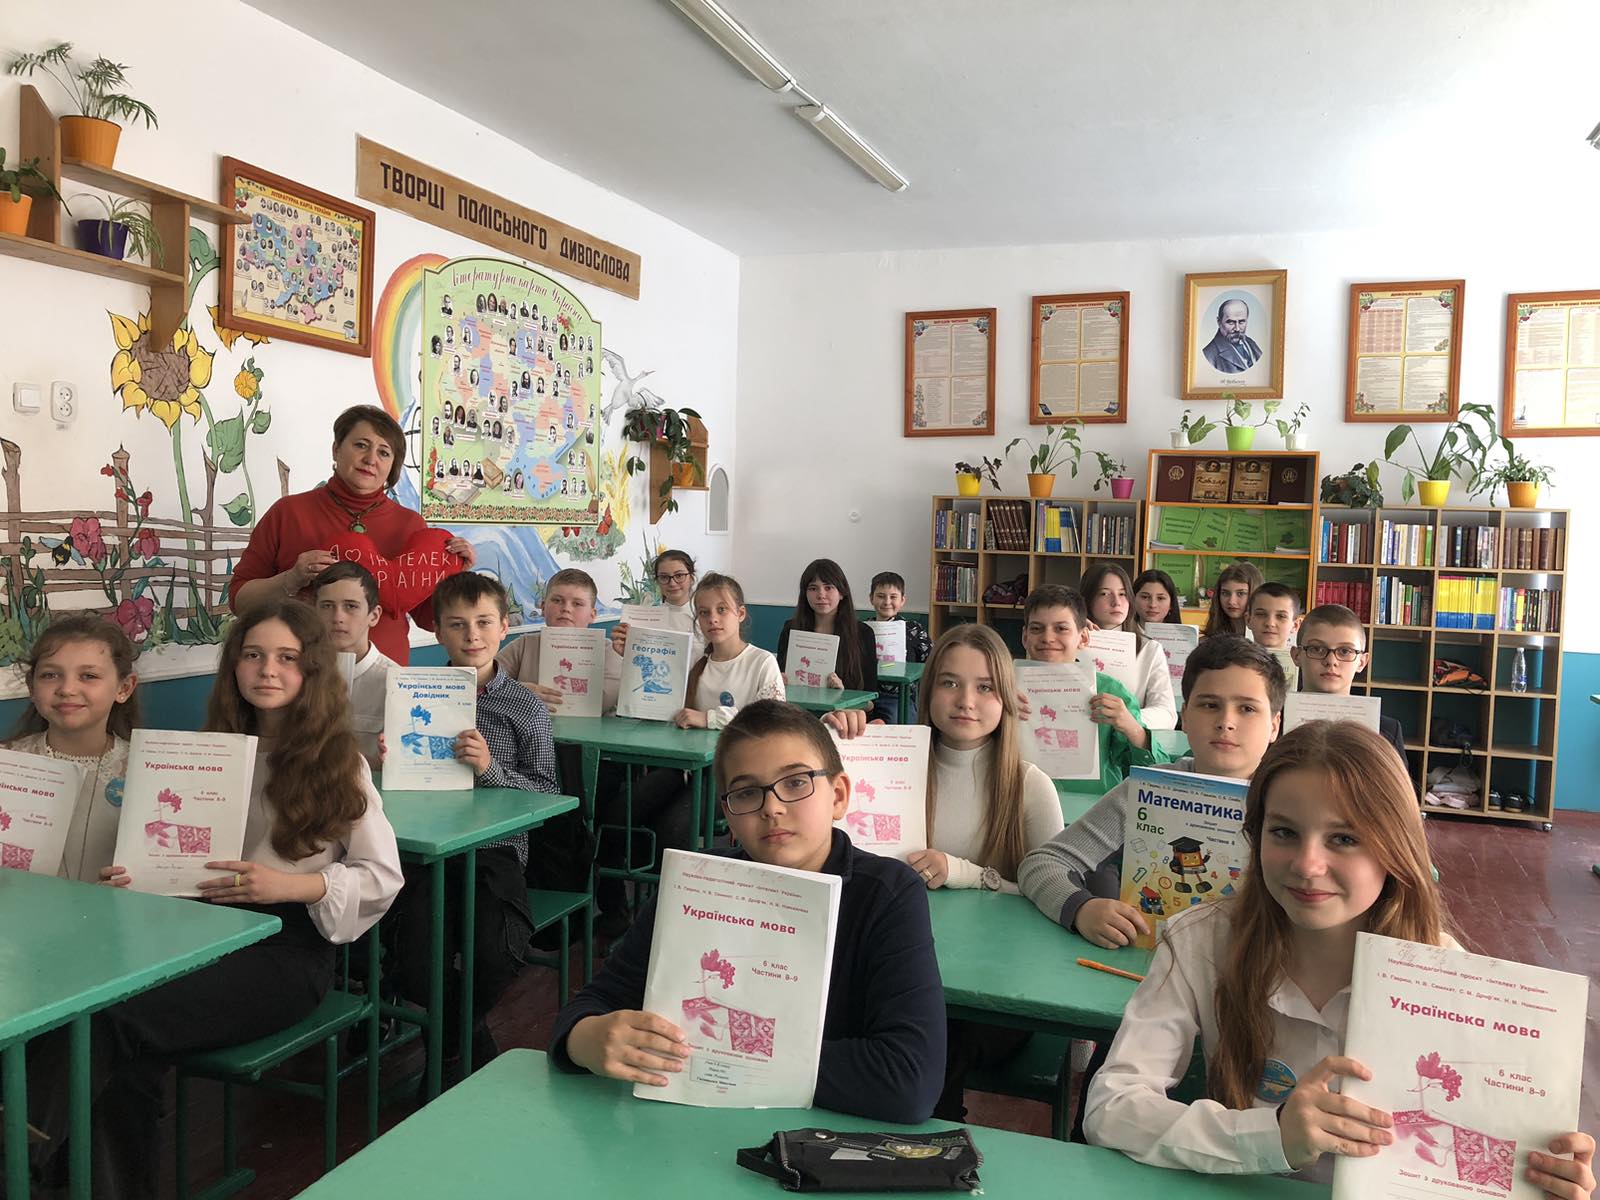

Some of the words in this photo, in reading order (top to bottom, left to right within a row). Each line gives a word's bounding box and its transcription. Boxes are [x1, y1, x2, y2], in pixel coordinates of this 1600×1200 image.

[380, 161, 445, 211] ТВОРЦІ
[458, 194, 547, 250] ПОЛІСЬКОГО
[559, 236, 630, 282] ДИВОСЛОВА
[631, 643, 677, 656] Географія
[397, 681, 442, 691] Українська
[412, 691, 450, 700] Довідник
[145, 761, 194, 772] Українська
[198, 765, 223, 773] мова
[0, 782, 28, 793] їнська
[31, 789, 55, 798] мова
[1138, 788, 1243, 821] Математика
[1137, 807, 1147, 821] 6
[1136, 822, 1165, 835] клас
[1162, 855, 1169, 864] 8
[1210, 871, 1218, 880] 4
[1173, 896, 1181, 906] 5
[682, 904, 755, 927] Українська
[760, 921, 796, 935] мова
[763, 960, 768, 968] 6
[770, 962, 788, 971] клас
[752, 967, 781, 979] Частини
[1390, 995, 1485, 1028] Українська
[1493, 1020, 1541, 1039] мова
[1498, 1068, 1505, 1077] 6
[1509, 1072, 1533, 1083] клас
[1484, 1076, 1524, 1093] Частини
[1399, 1169, 1421, 1179] Зошит
